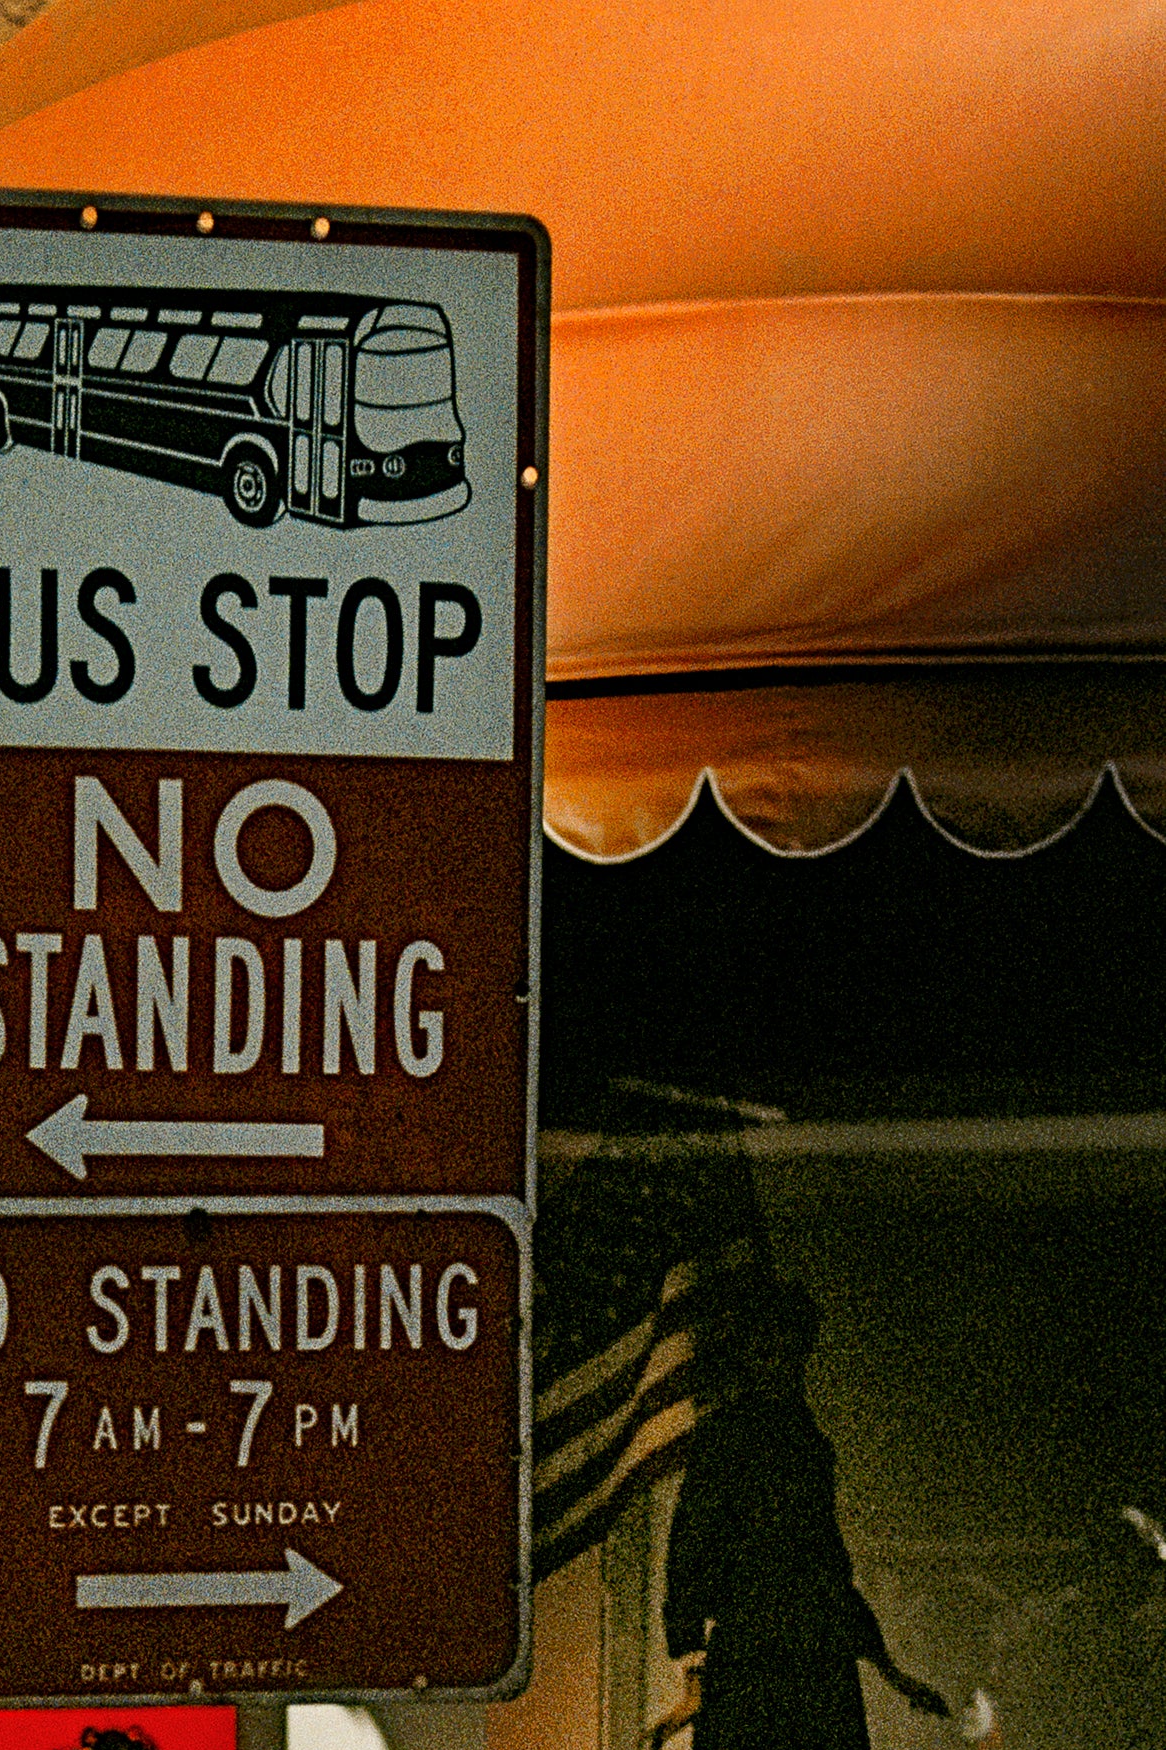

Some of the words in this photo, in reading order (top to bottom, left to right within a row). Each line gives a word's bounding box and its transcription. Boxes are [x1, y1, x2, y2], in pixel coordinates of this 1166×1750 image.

[192, 572, 483, 715] STOP
[73, 775, 337, 918] NO
[86, 1262, 479, 1354] STANDING
[24, 1380, 70, 1469] 7
[92, 1407, 162, 1450] AM
[229, 1380, 274, 1467] 7
[294, 1403, 359, 1448] PM
[48, 1504, 171, 1529] EXCEPT
[212, 1501, 342, 1527] SUNDAY
[81, 1662, 139, 1681] DEPT
[161, 1661, 189, 1680] OF
[209, 1658, 308, 1679] TRAFFIC
